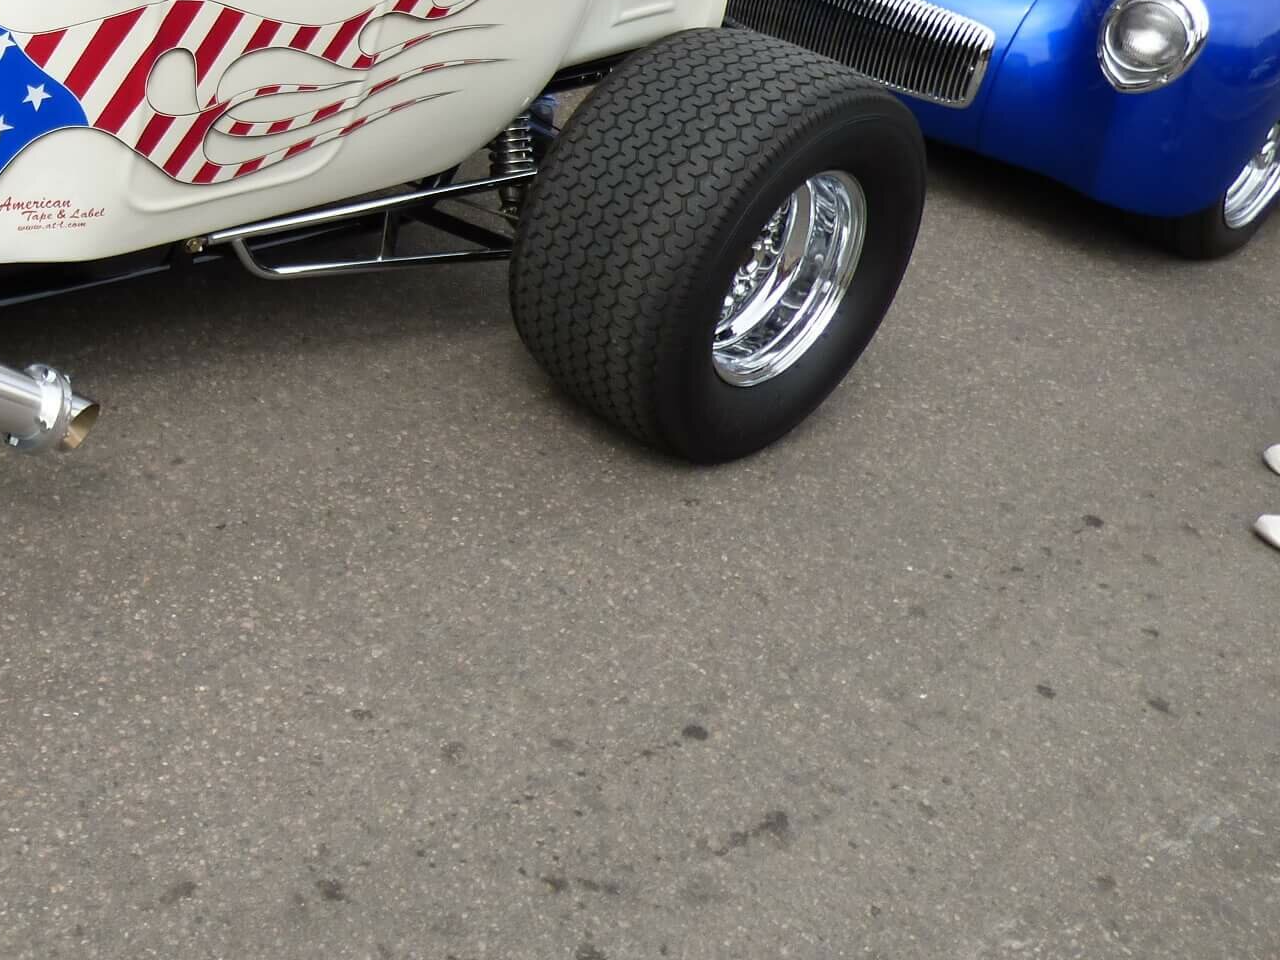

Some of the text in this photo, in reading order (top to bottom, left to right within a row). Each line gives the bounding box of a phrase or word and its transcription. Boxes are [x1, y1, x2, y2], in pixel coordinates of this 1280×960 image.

[21, 208, 105, 222] Tape & Label
